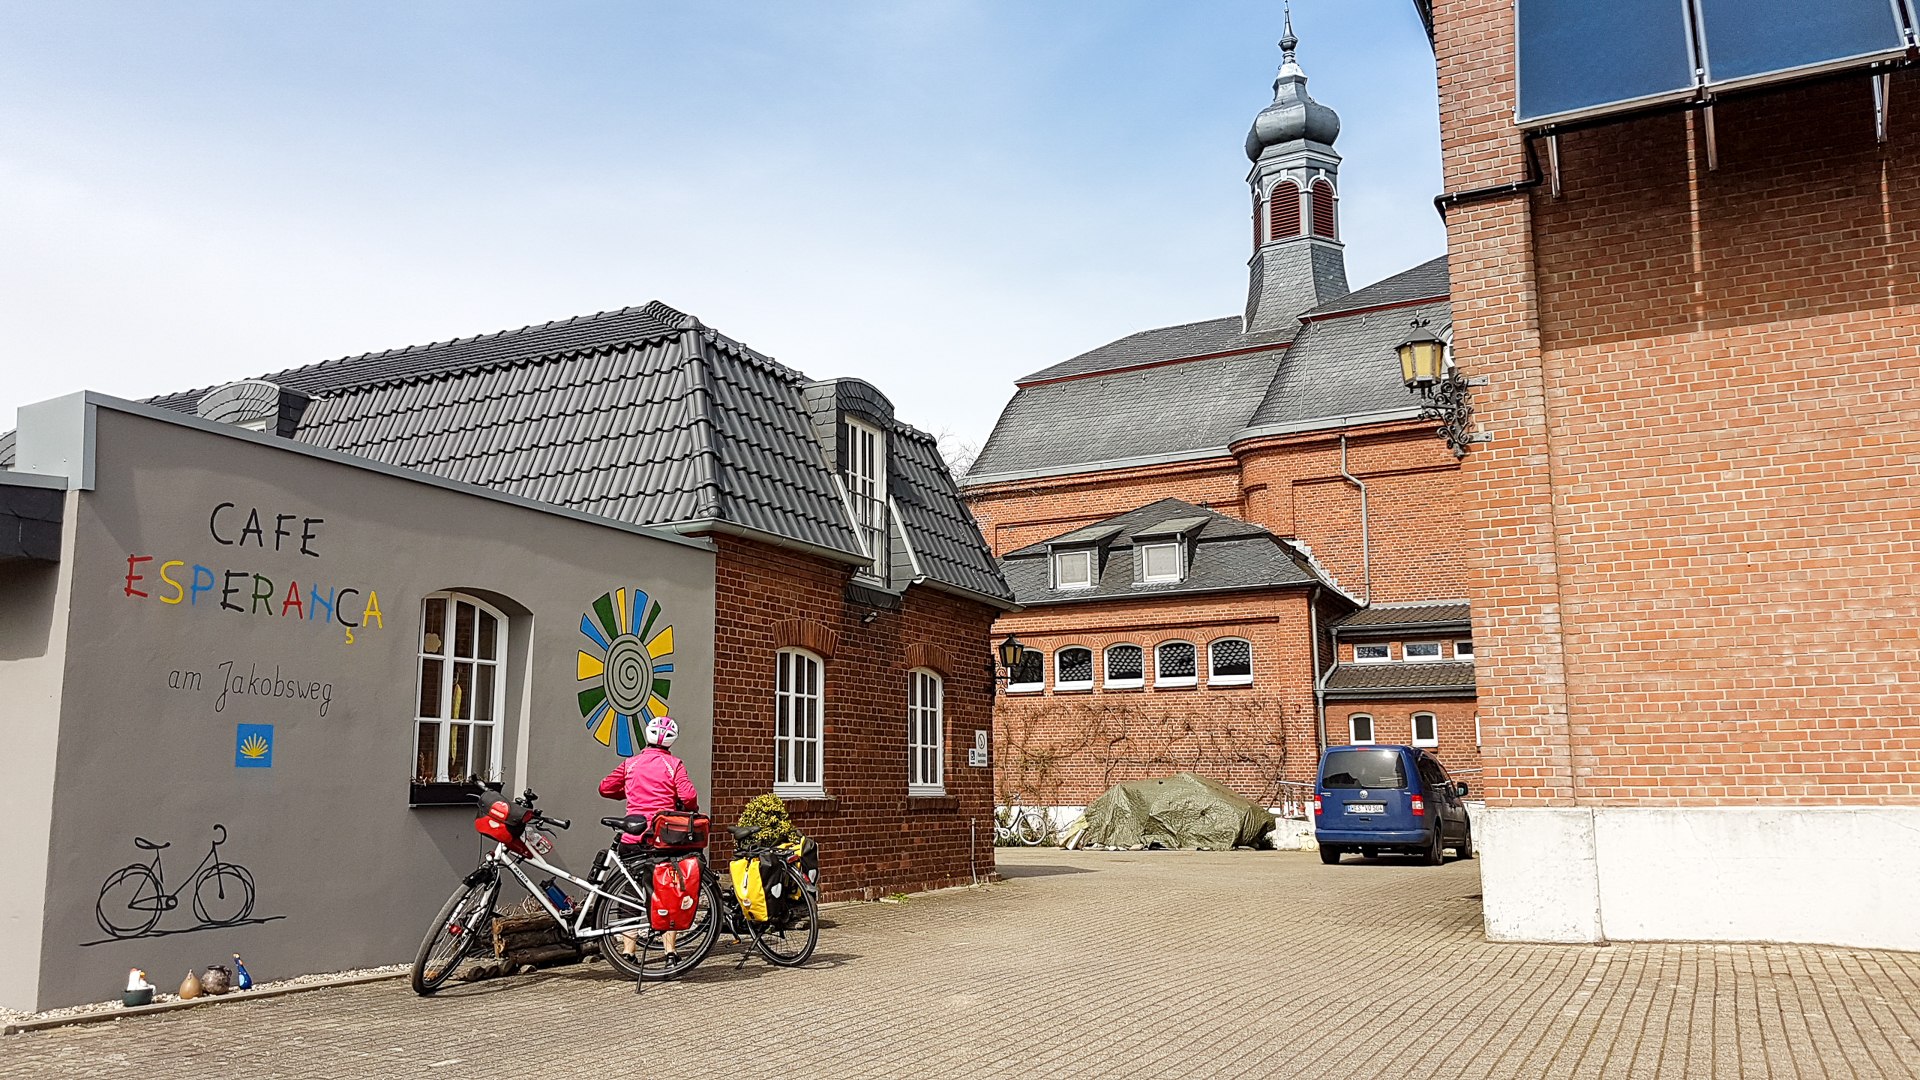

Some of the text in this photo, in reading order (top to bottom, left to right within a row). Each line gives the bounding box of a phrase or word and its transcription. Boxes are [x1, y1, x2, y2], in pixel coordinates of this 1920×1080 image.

[210, 502, 324, 557] CAFE
[123, 553, 383, 644] ESPERANÇA
[168, 660, 333, 717] am Jakobsweg
